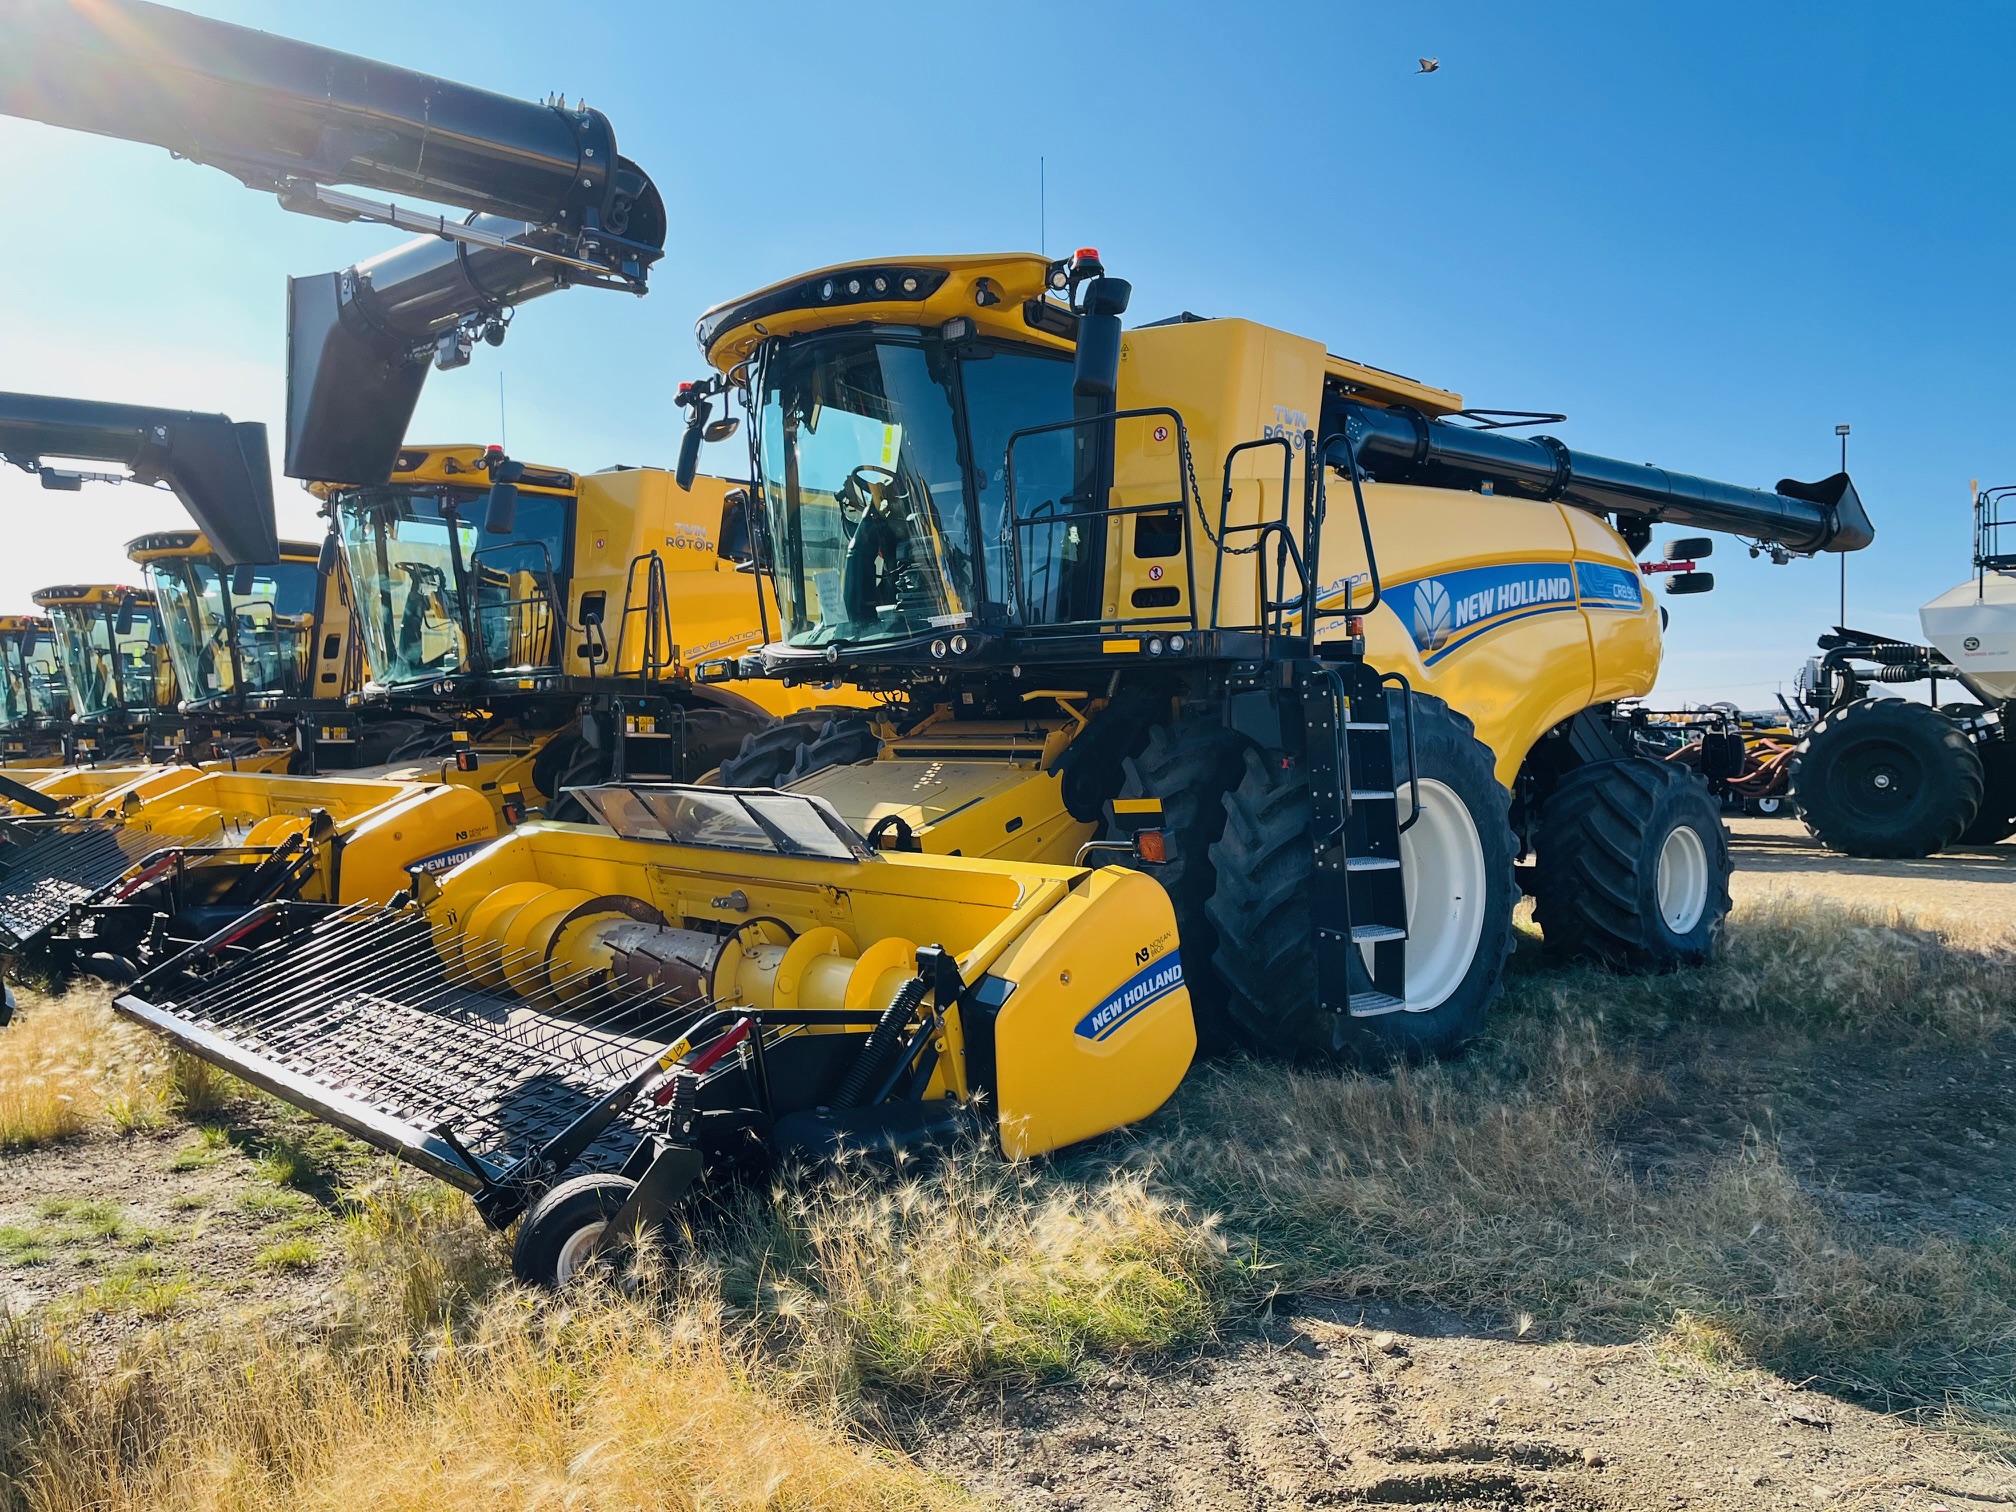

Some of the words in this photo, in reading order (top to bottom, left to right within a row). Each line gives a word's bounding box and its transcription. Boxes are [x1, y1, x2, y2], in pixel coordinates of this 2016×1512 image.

[1273, 405, 1308, 429] TWIN
[1263, 424, 1305, 450] ROTO
[665, 534, 715, 552] ROTOR
[674, 522, 707, 538] TWIN
[1455, 588, 1495, 628] NEW
[1497, 577, 1571, 611] HOLLAND
[683, 629, 763, 657] REVELATION
[1091, 997, 1123, 1031] NEW
[1124, 964, 1183, 1008] HOLLAND
